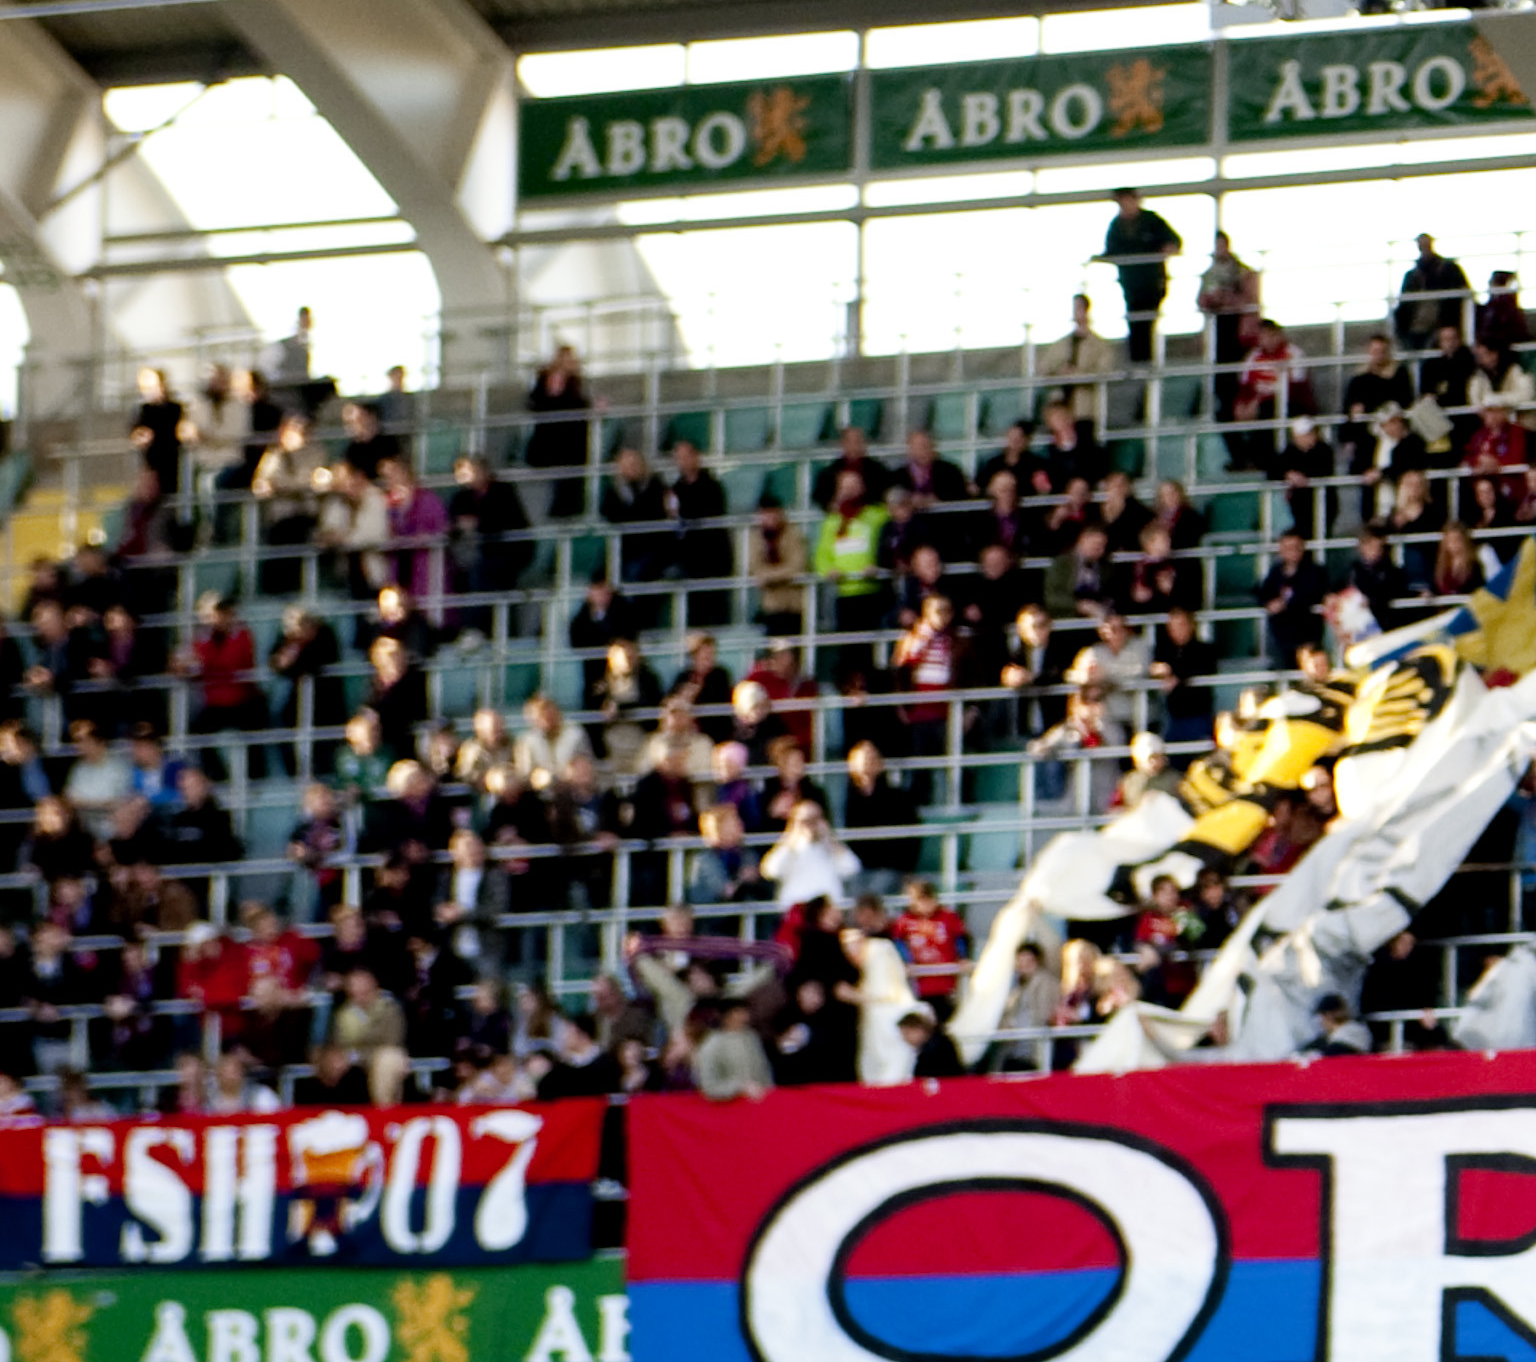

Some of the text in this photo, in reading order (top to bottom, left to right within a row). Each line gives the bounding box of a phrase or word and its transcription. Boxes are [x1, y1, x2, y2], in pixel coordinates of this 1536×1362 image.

[903, 82, 1103, 153] ÅBRO
[1262, 53, 1466, 126] ÅBRO
[552, 112, 746, 182] ÅBRO
[40, 1123, 279, 1264] FSH
